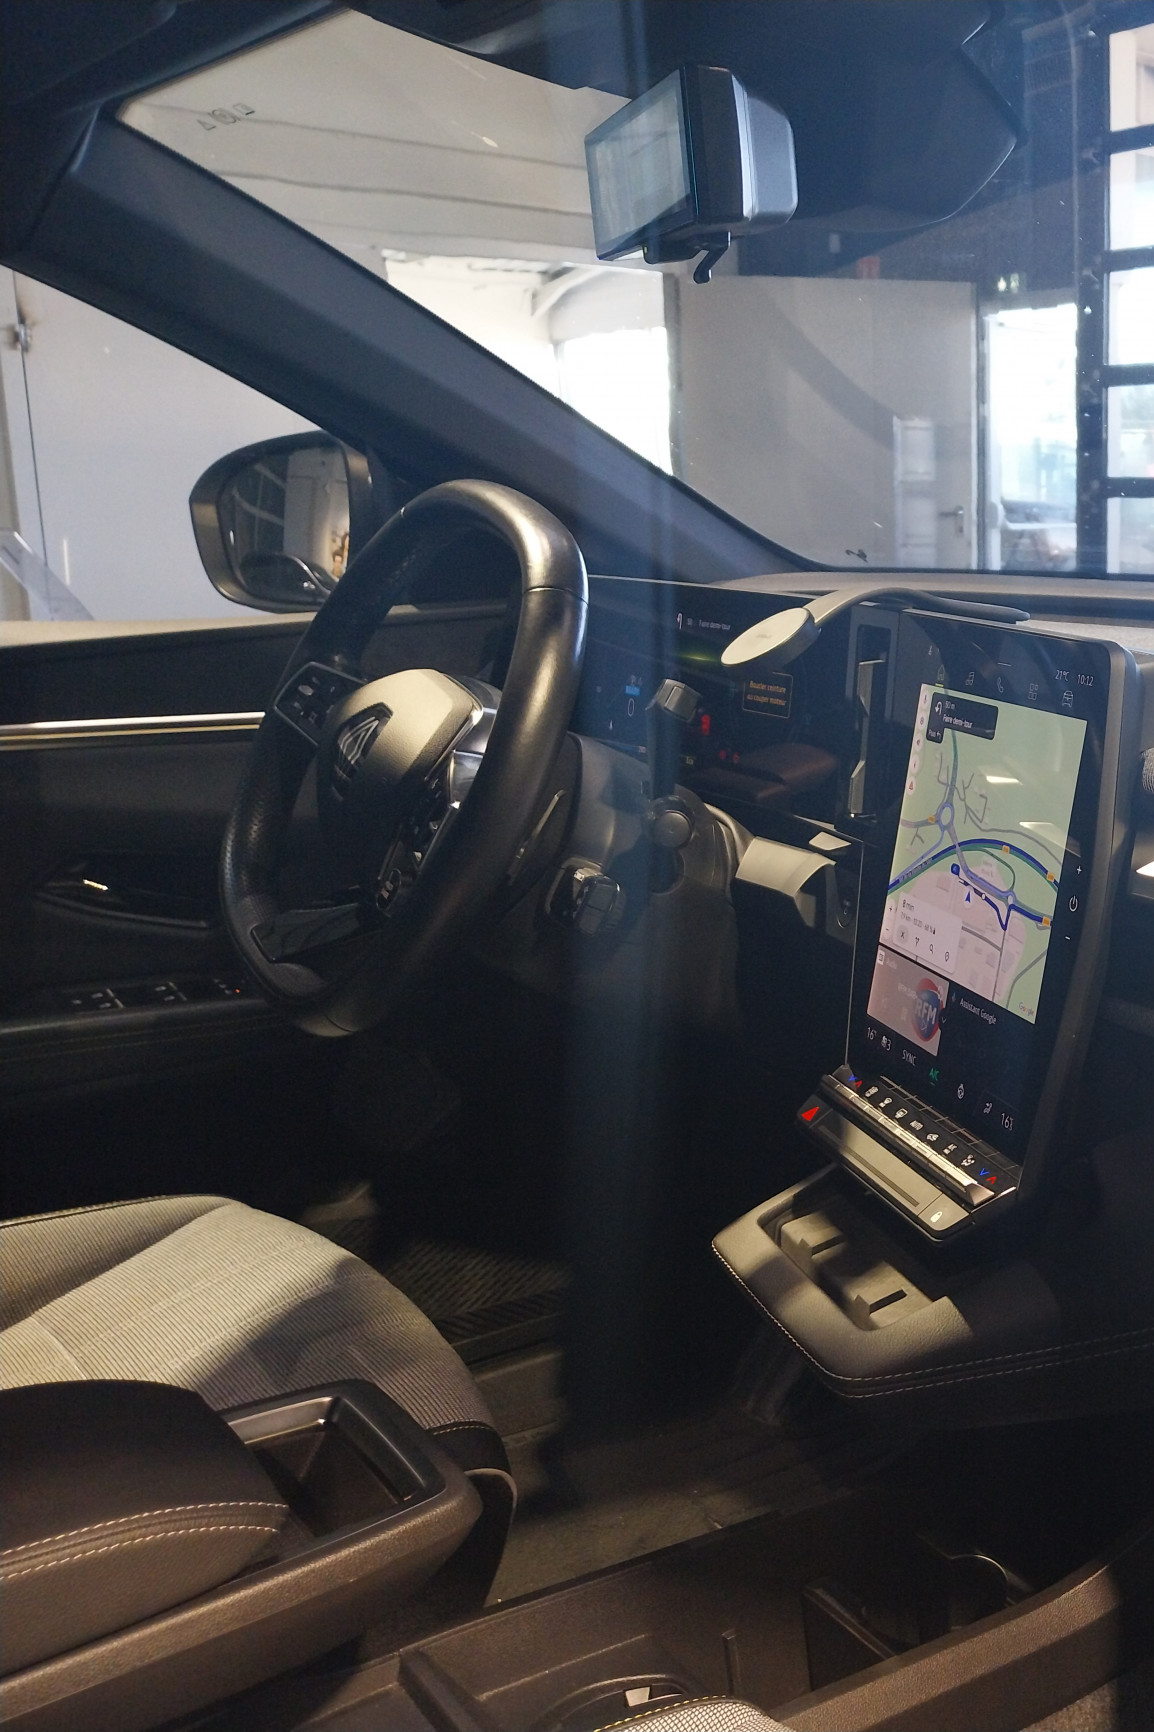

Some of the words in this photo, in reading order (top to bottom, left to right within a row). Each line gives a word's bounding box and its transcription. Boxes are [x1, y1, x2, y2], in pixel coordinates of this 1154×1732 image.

[1077, 674, 1094, 687] 10:12
[914, 998, 938, 1025] RFM
[960, 998, 980, 1016] Assistant
[980, 1008, 997, 1025] Google
[902, 1049, 917, 1067] SYNC
